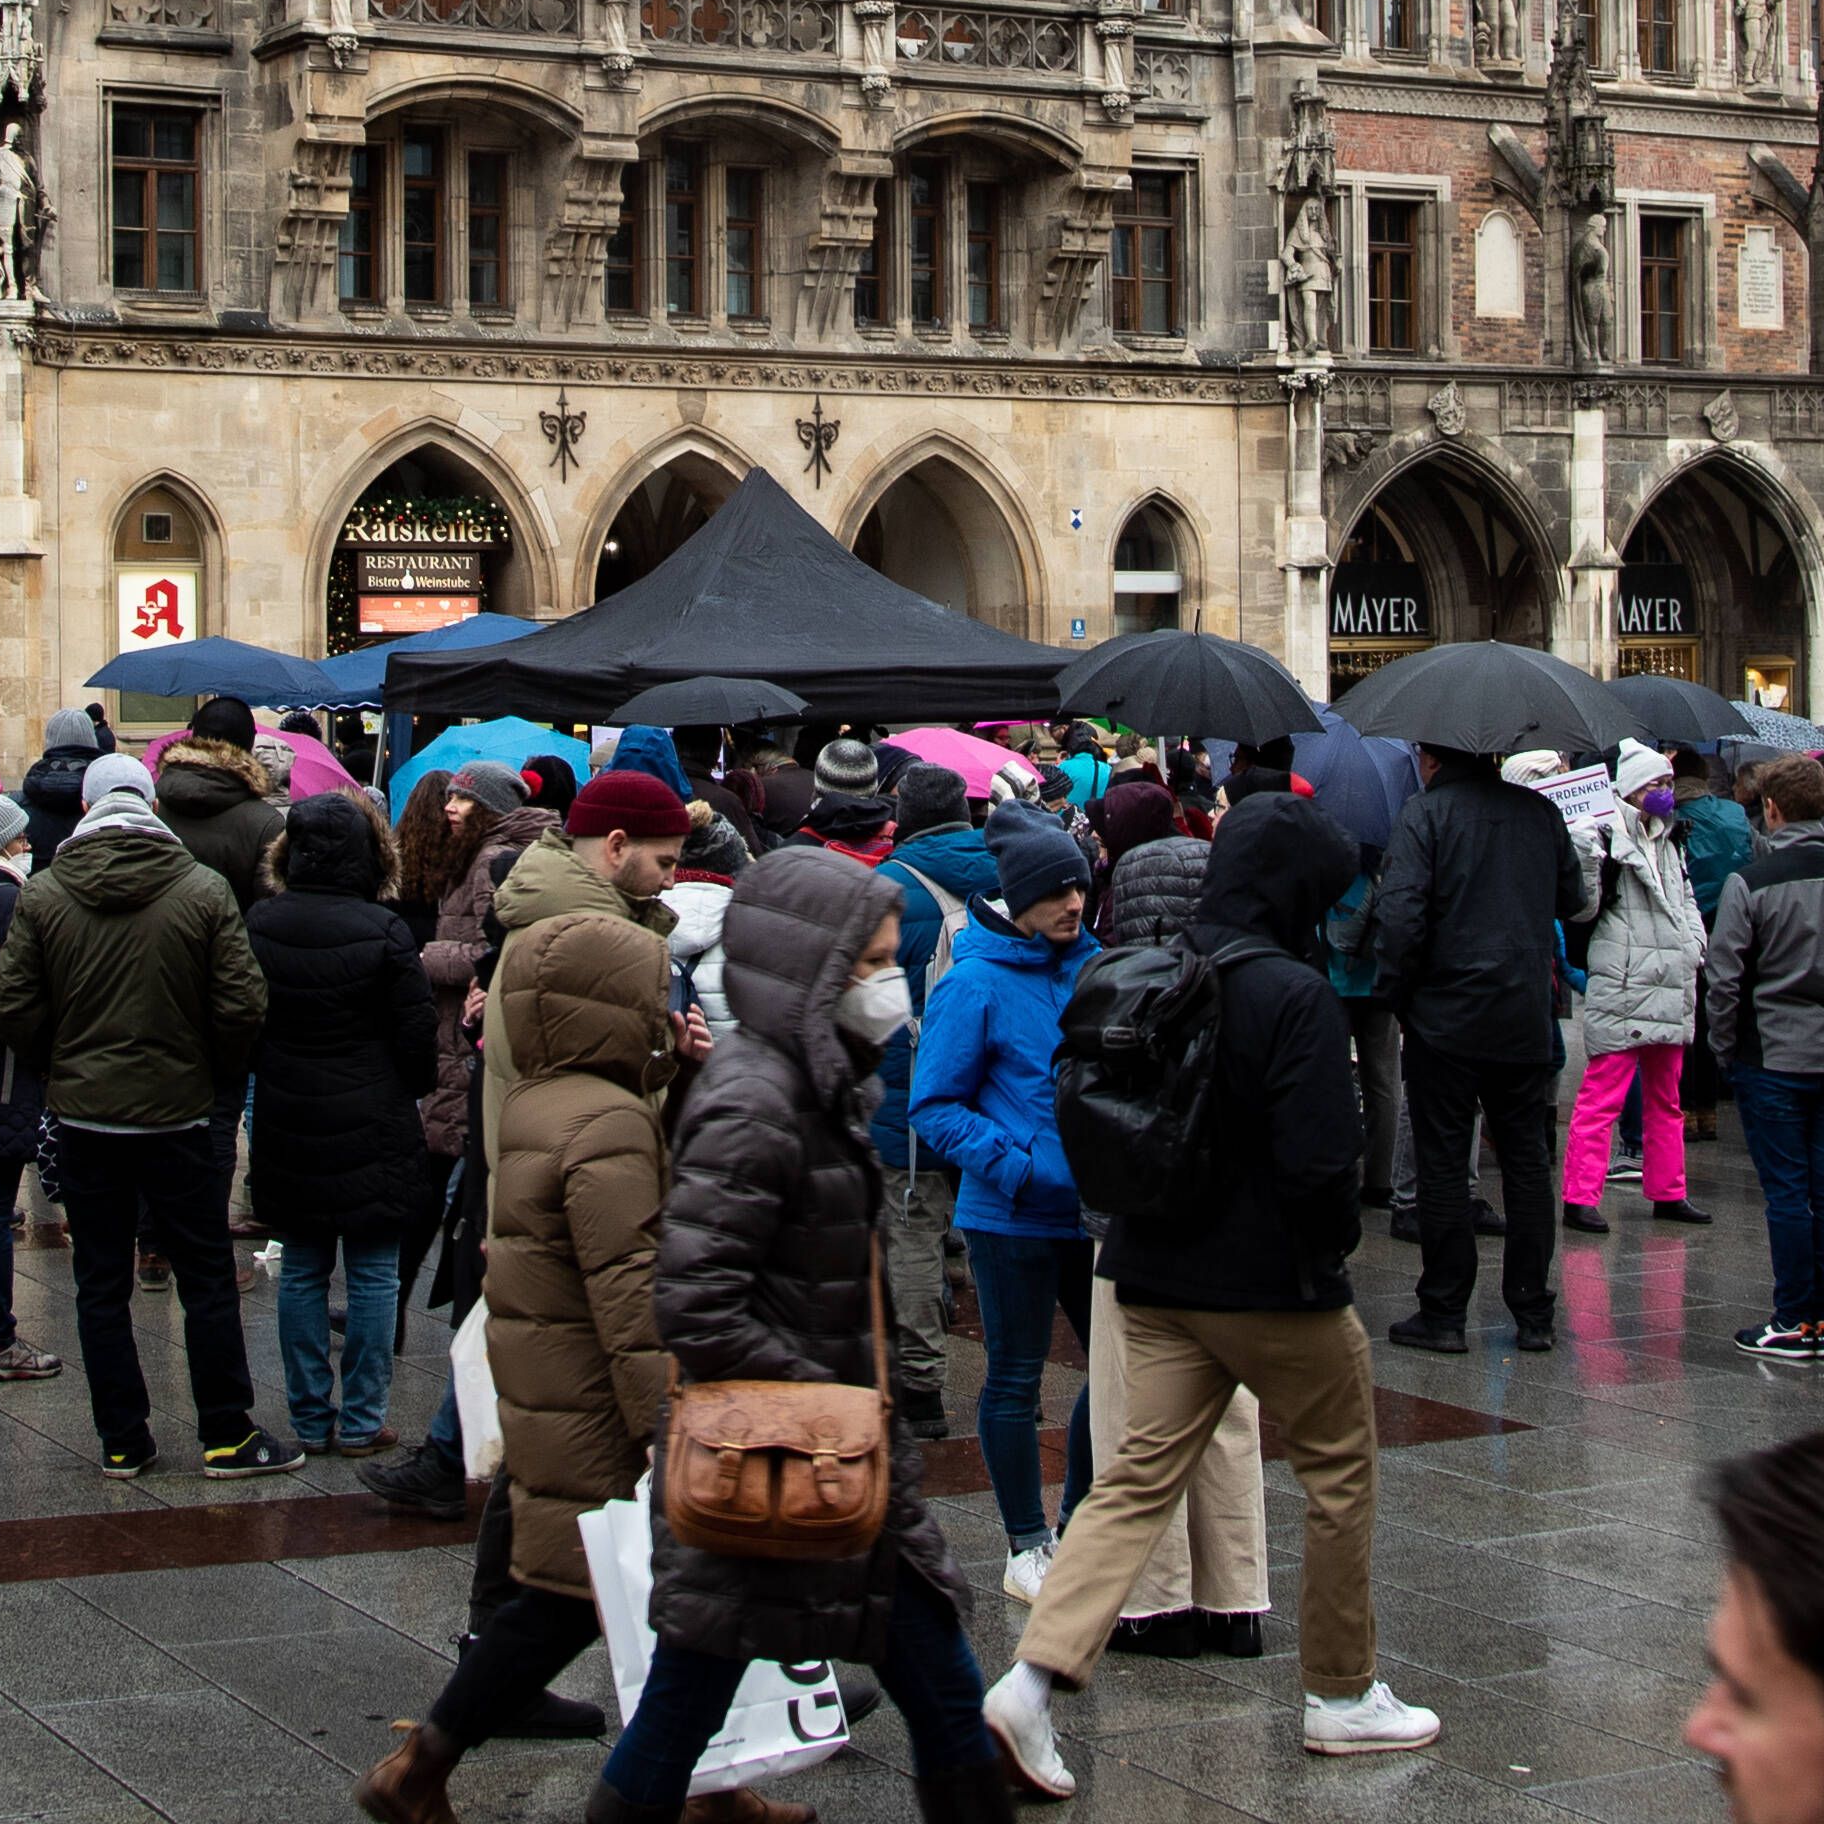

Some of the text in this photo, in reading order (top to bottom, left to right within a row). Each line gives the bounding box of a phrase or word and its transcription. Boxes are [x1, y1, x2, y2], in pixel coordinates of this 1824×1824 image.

[365, 555, 473, 570] RESTAURANT
[368, 575, 471, 588] Bistro Weinstube
[1333, 592, 1418, 633] MAYER
[1546, 778, 1609, 803] ERDENKEN
